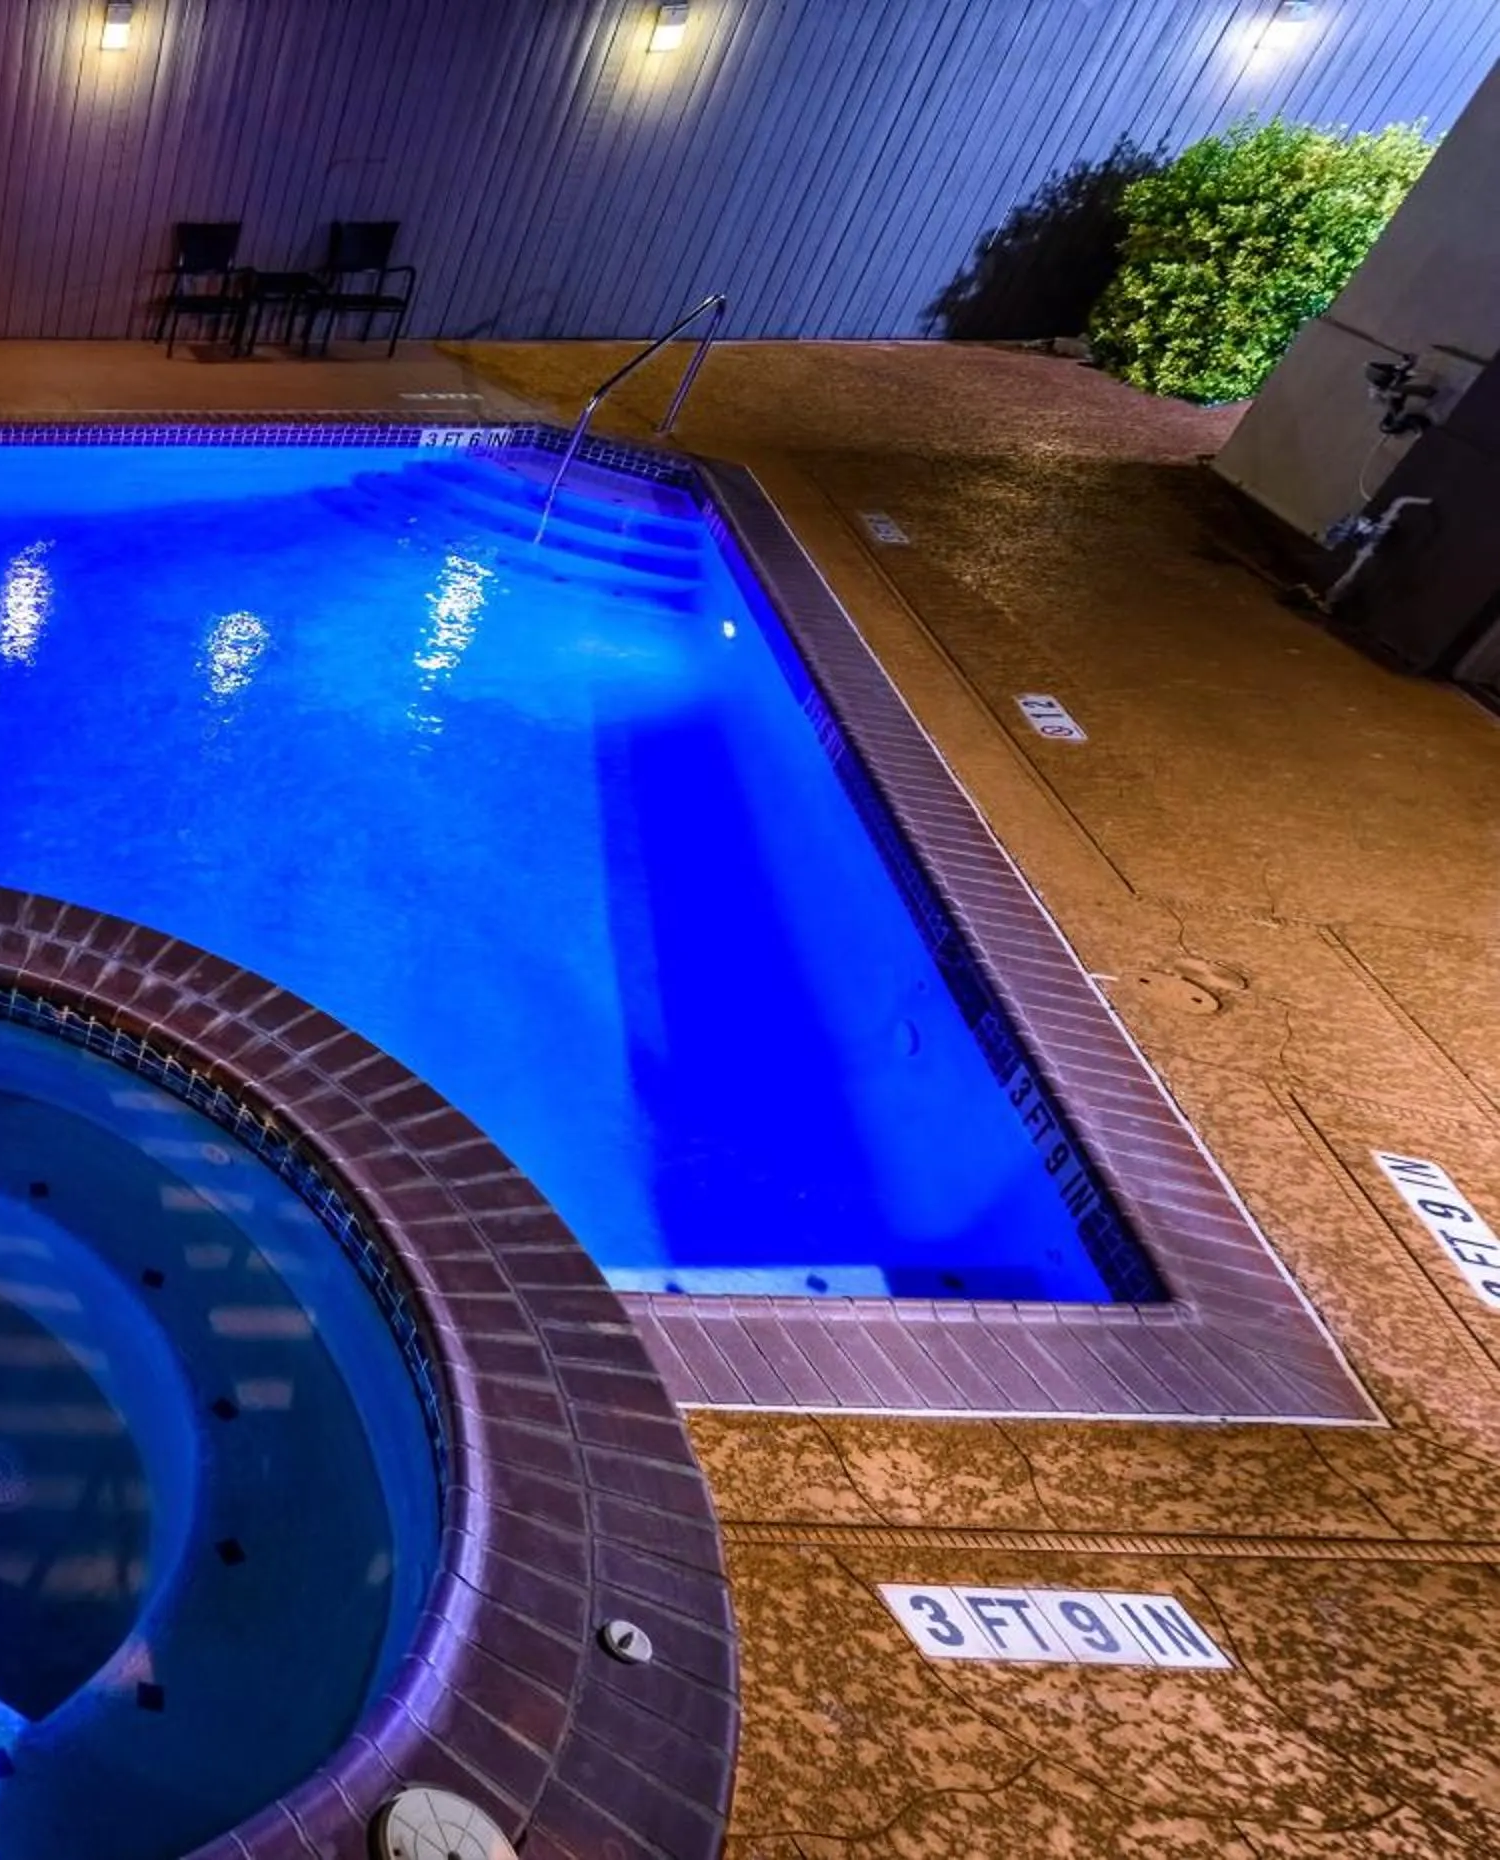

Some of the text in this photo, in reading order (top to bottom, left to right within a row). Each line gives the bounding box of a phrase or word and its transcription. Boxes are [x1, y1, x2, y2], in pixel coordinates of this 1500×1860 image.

[425, 431, 507, 448] 3 FT 6 IN
[1009, 1077, 1097, 1218] 3 FT 9 IN
[1380, 1155, 1500, 1269] FT 9 IN
[909, 1594, 1212, 1658] 3 FT 9 IN
